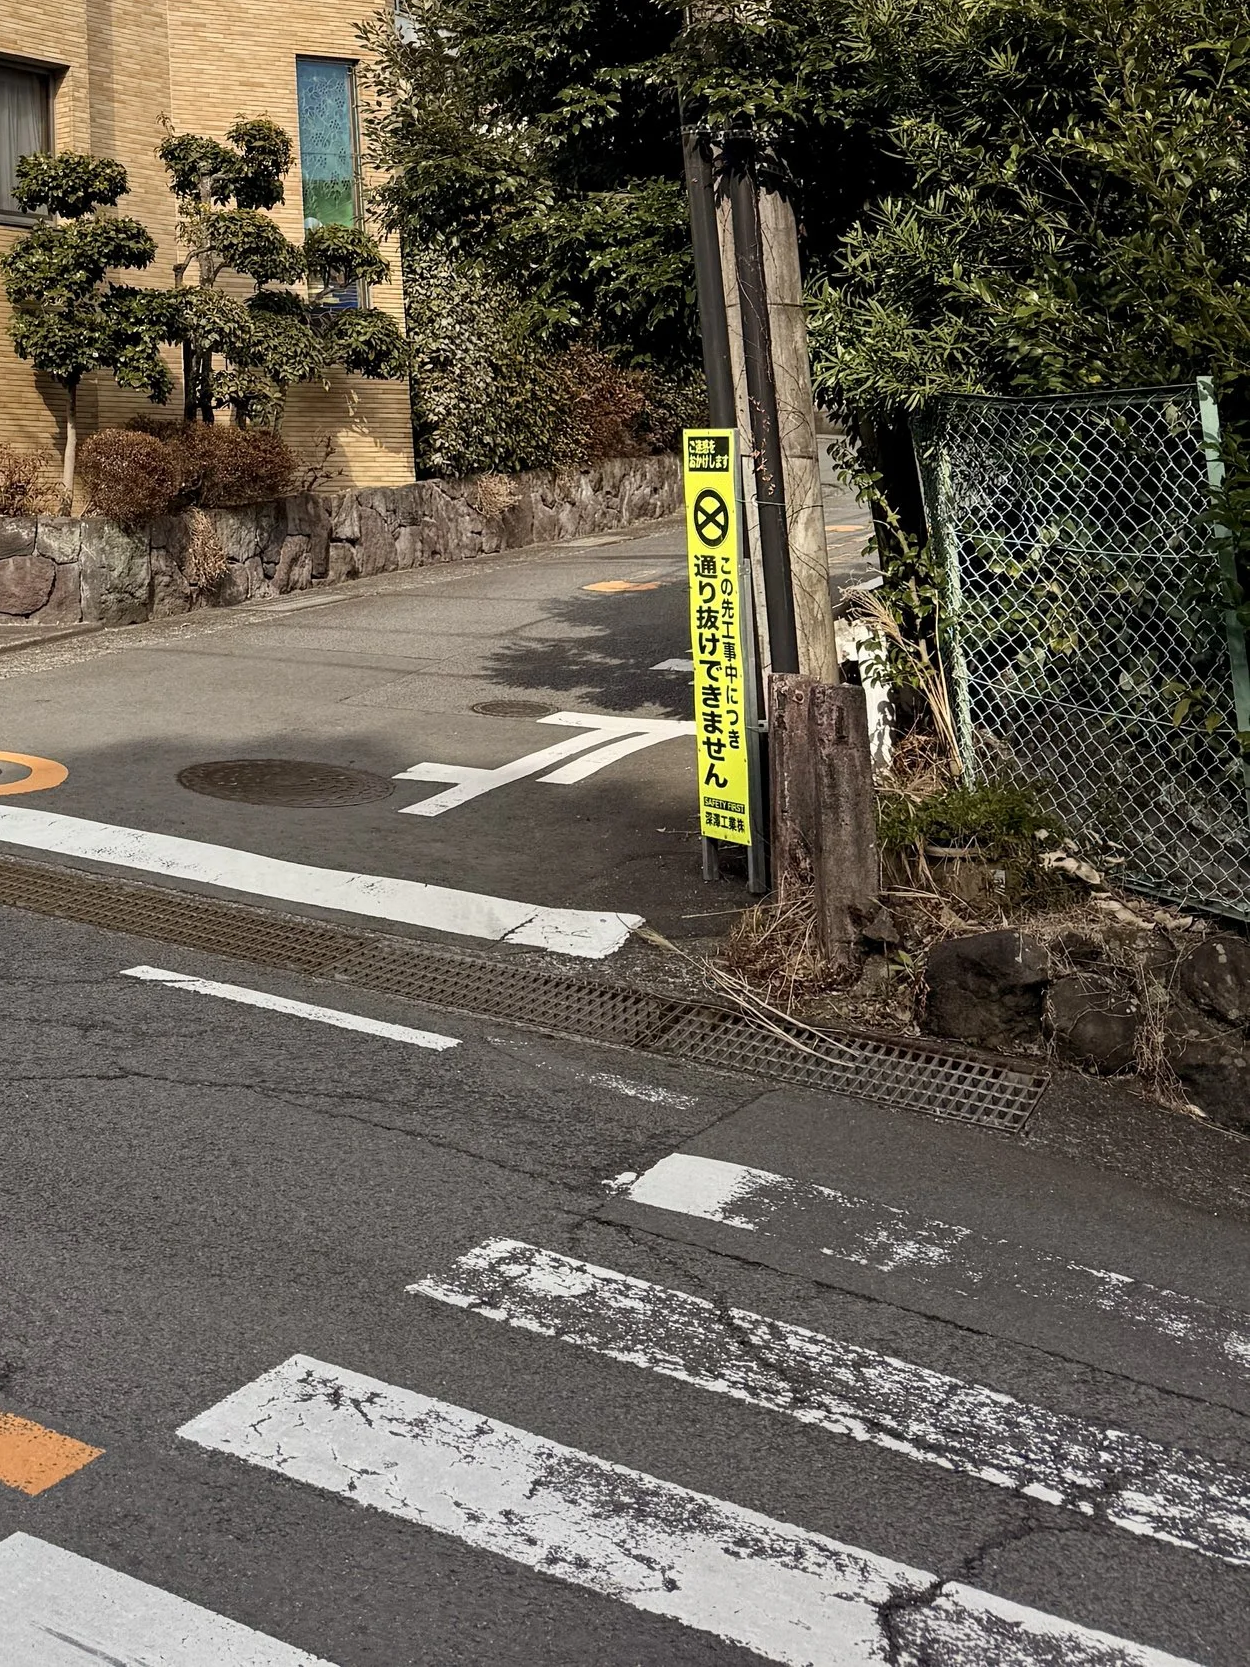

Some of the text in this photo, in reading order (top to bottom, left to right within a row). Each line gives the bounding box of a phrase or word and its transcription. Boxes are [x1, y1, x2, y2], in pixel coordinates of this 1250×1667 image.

[689, 454, 729, 469] おかけします
[693, 554, 729, 789] 通り抜けできません
[720, 556, 740, 749] この先工事中につき
[704, 797, 744, 814] SAFETY FIRST
